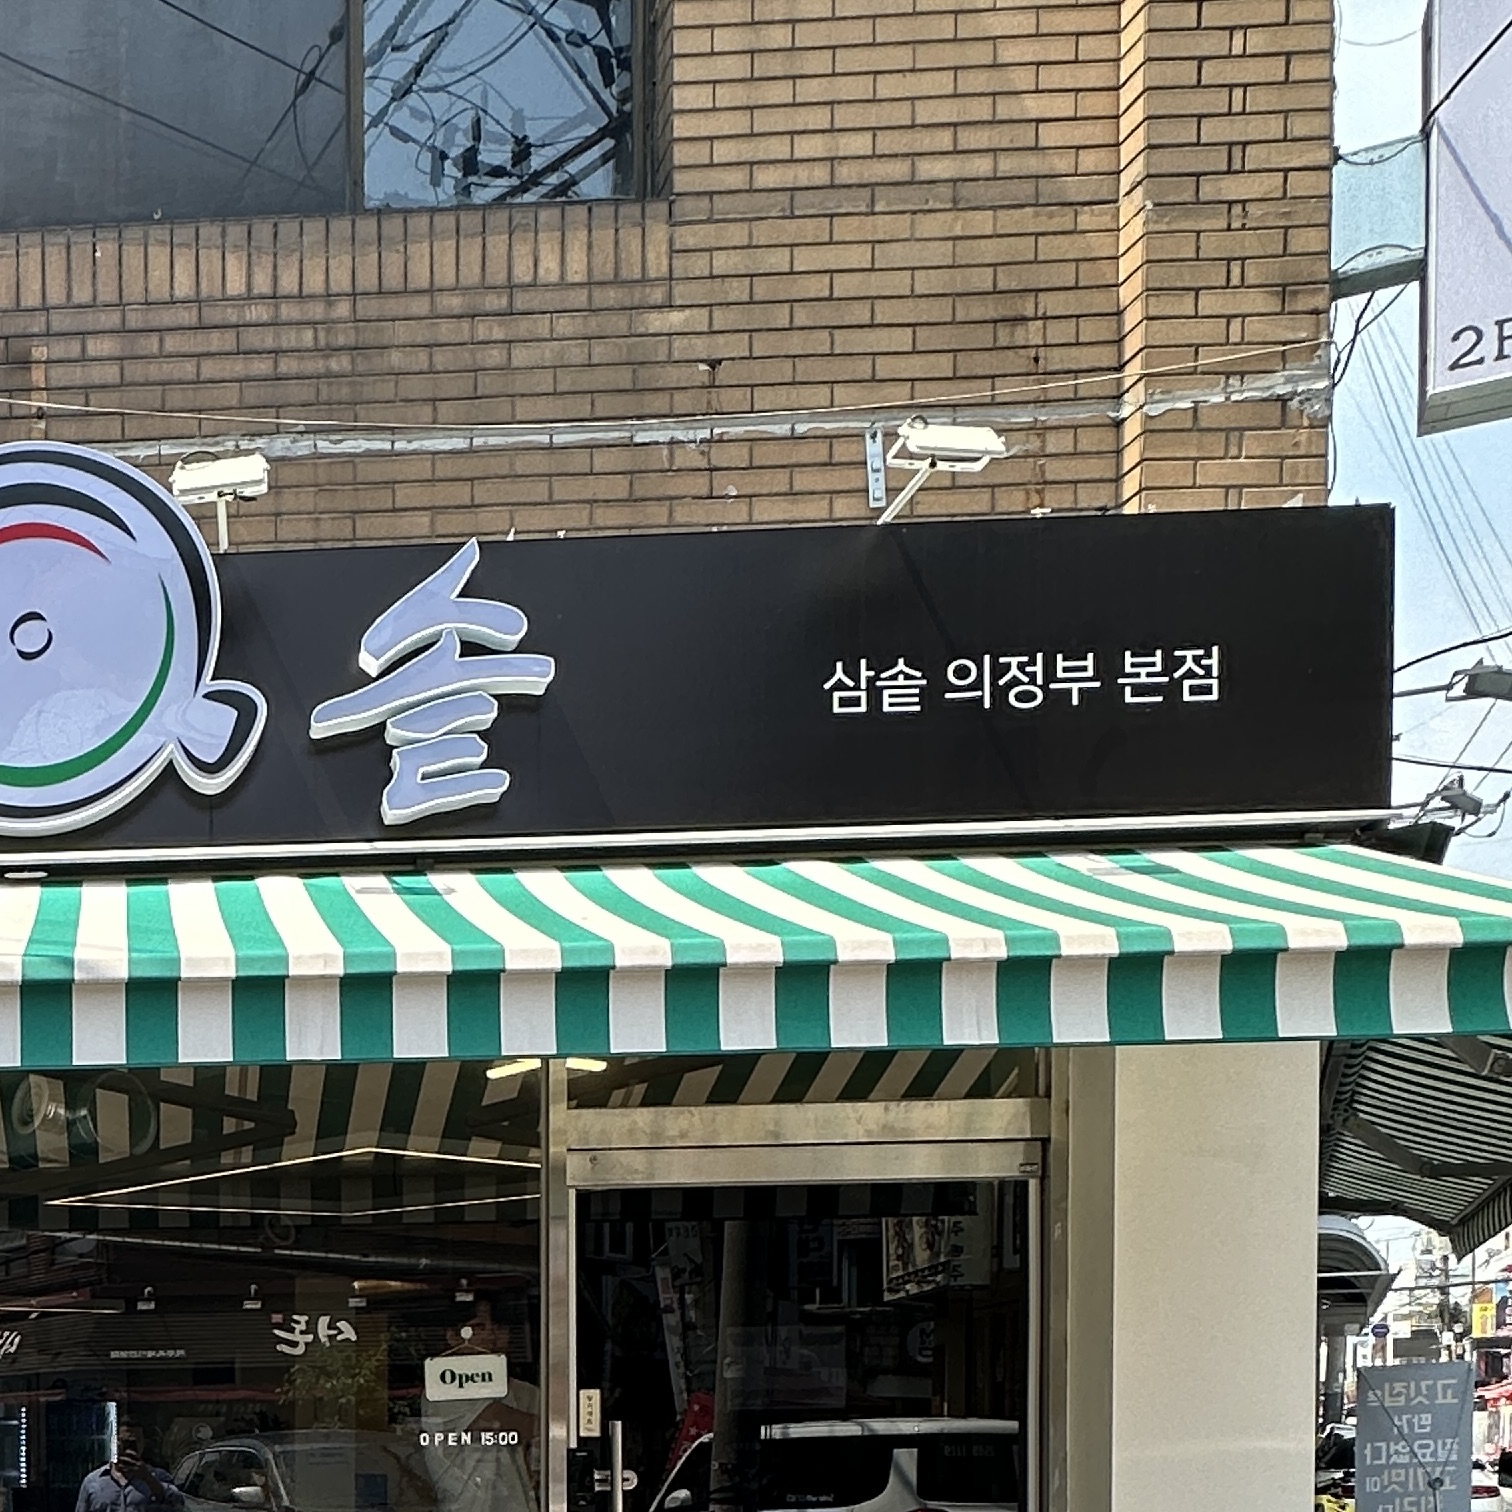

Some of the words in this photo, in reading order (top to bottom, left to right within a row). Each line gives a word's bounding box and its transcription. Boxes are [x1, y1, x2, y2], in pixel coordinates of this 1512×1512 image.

[823, 658, 927, 713] 삼솥
[945, 653, 1101, 708] 의정부
[1117, 646, 1218, 703] 본점
[439, 1367, 494, 1388] Open
[420, 1431, 472, 1446] OPEN
[480, 1430, 519, 1446] 15:00
